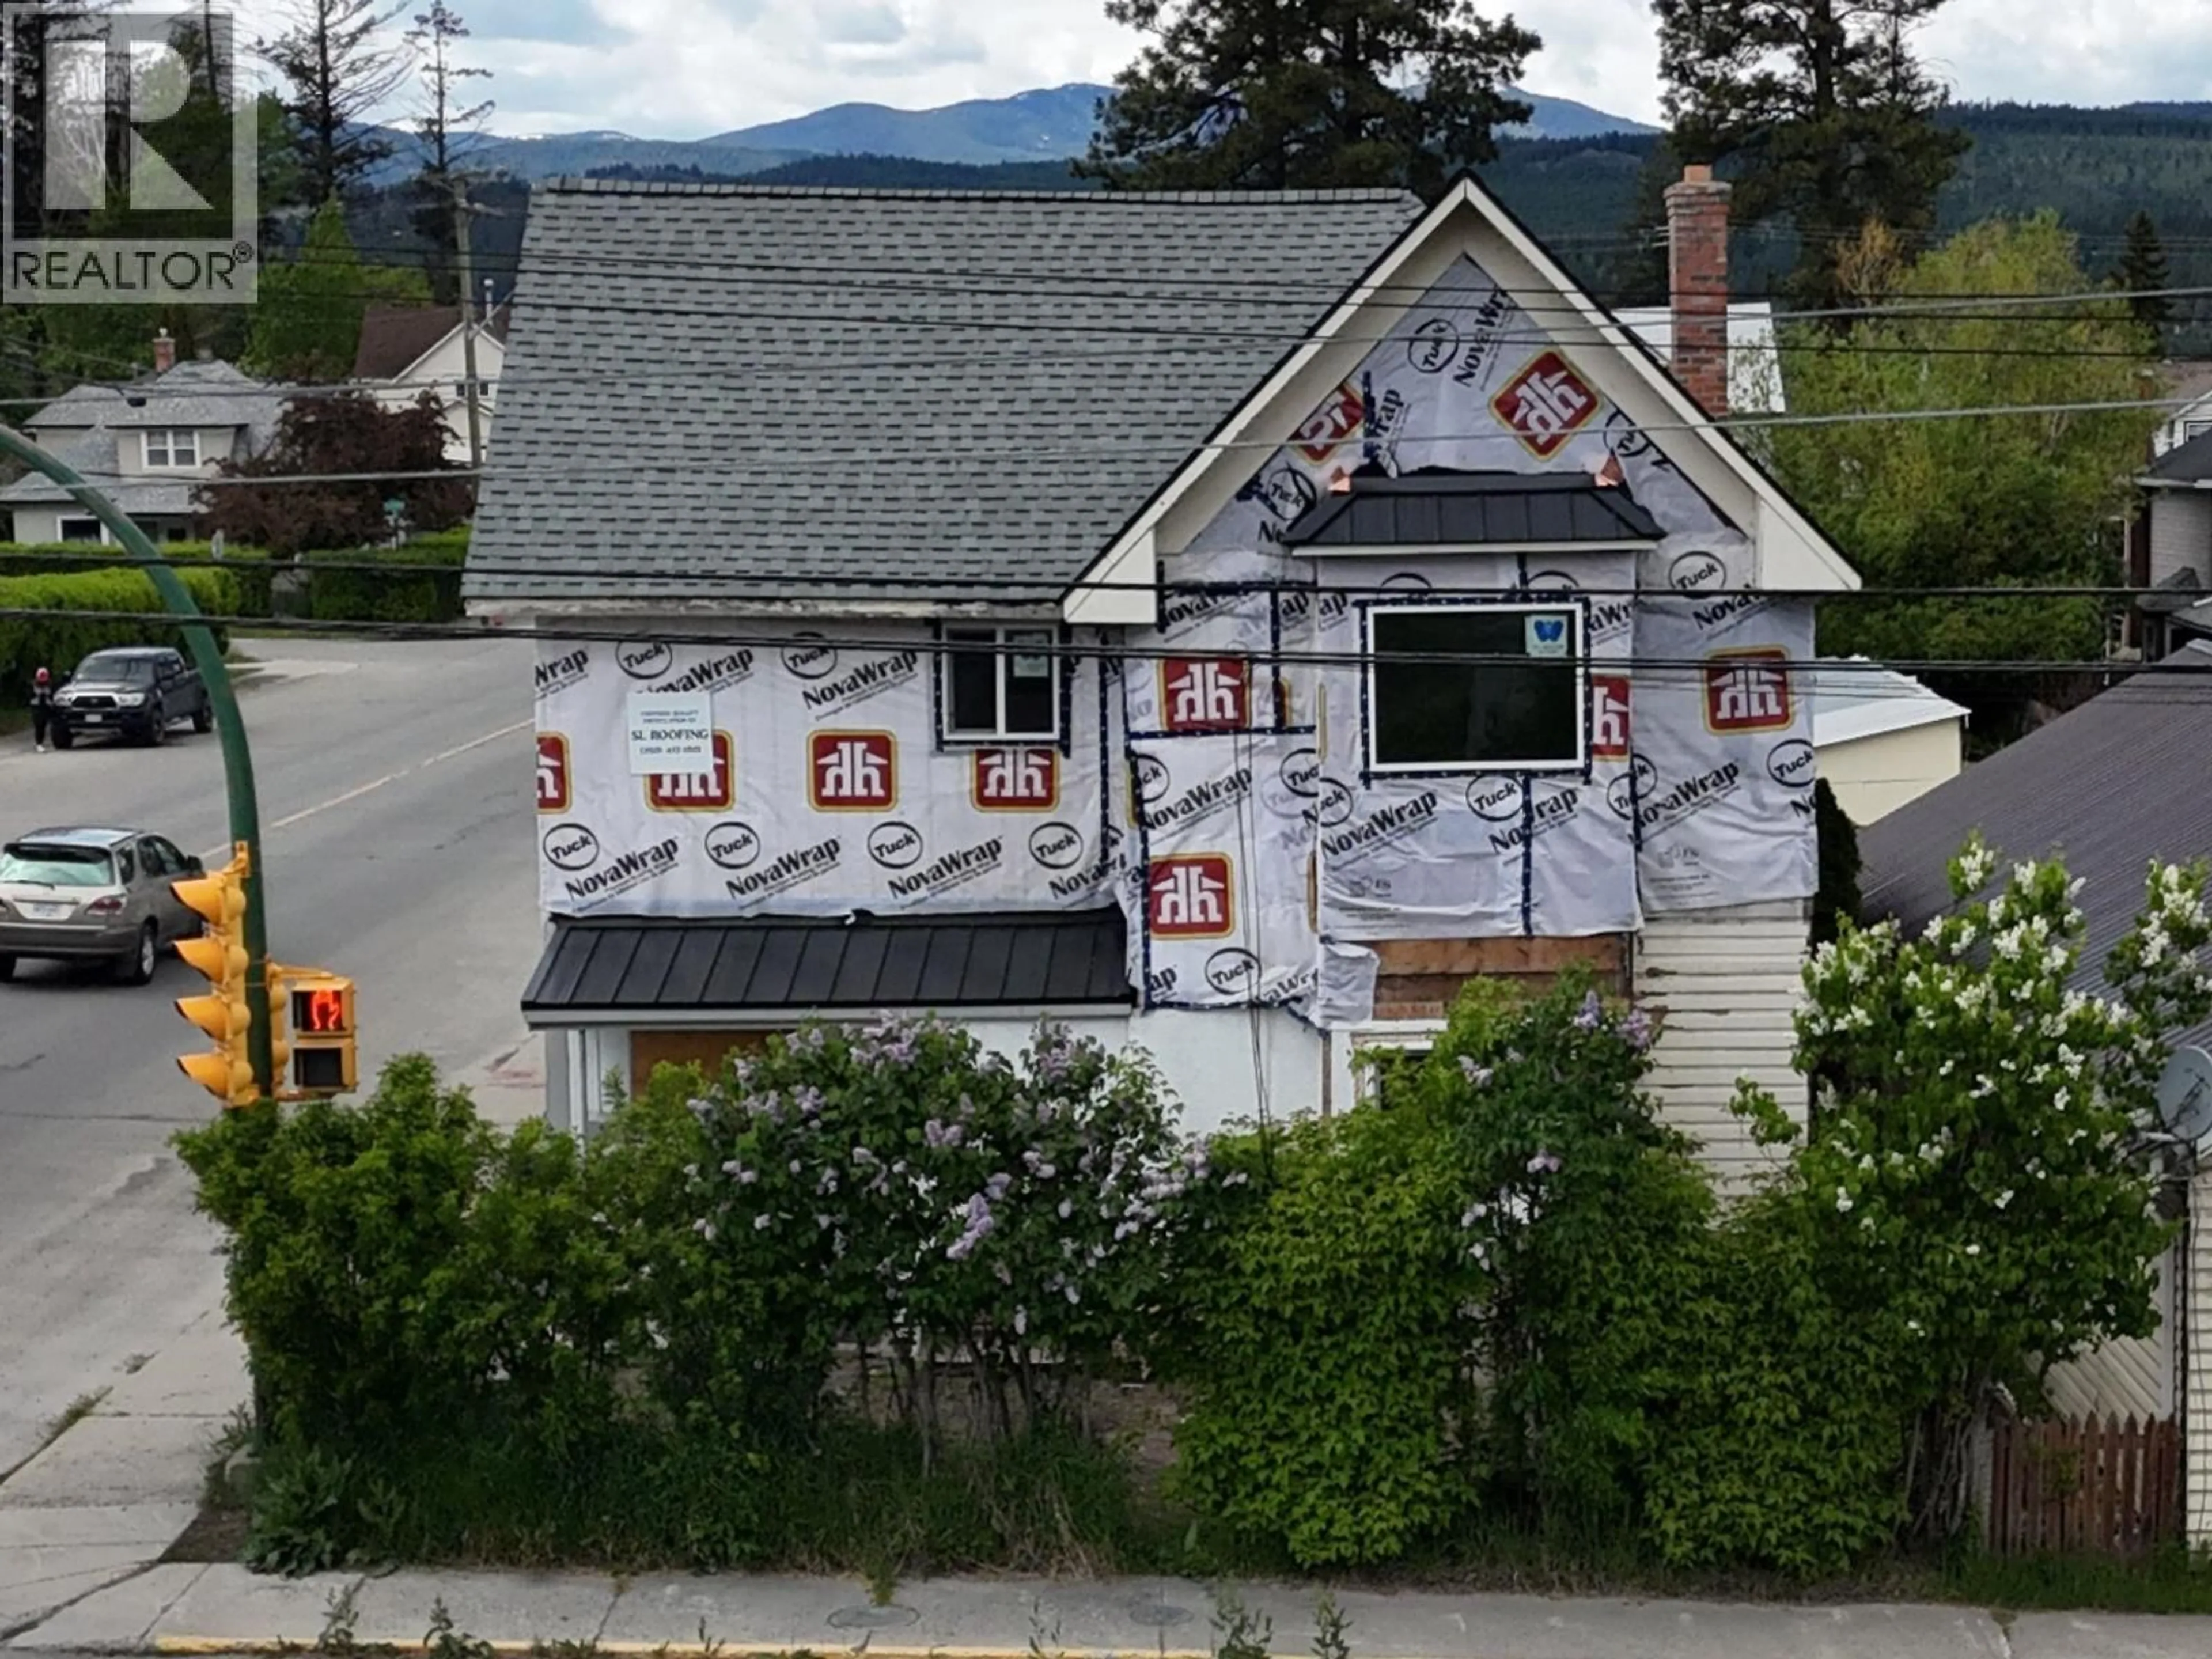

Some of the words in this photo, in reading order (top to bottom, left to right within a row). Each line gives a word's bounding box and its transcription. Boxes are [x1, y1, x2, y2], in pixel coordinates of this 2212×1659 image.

[1676, 562, 1718, 589] Tuck
[623, 642, 664, 668] Tuck
[802, 651, 918, 710] NovaWrap
[650, 729, 709, 740] ROOFING
[1774, 751, 1813, 778] Tuck
[1475, 783, 1517, 811] Tuck
[1321, 791, 1438, 856] NovaWrap
[551, 837, 593, 860] Tuck
[712, 834, 753, 859] Tuck
[874, 834, 915, 858] Tuck
[1036, 834, 1076, 858] Tuck
[565, 838, 679, 901] NovaWrap
[726, 838, 841, 899] NovaWrap
[888, 838, 1002, 899] NovaWrap
[1212, 959, 1255, 984] Tuck
